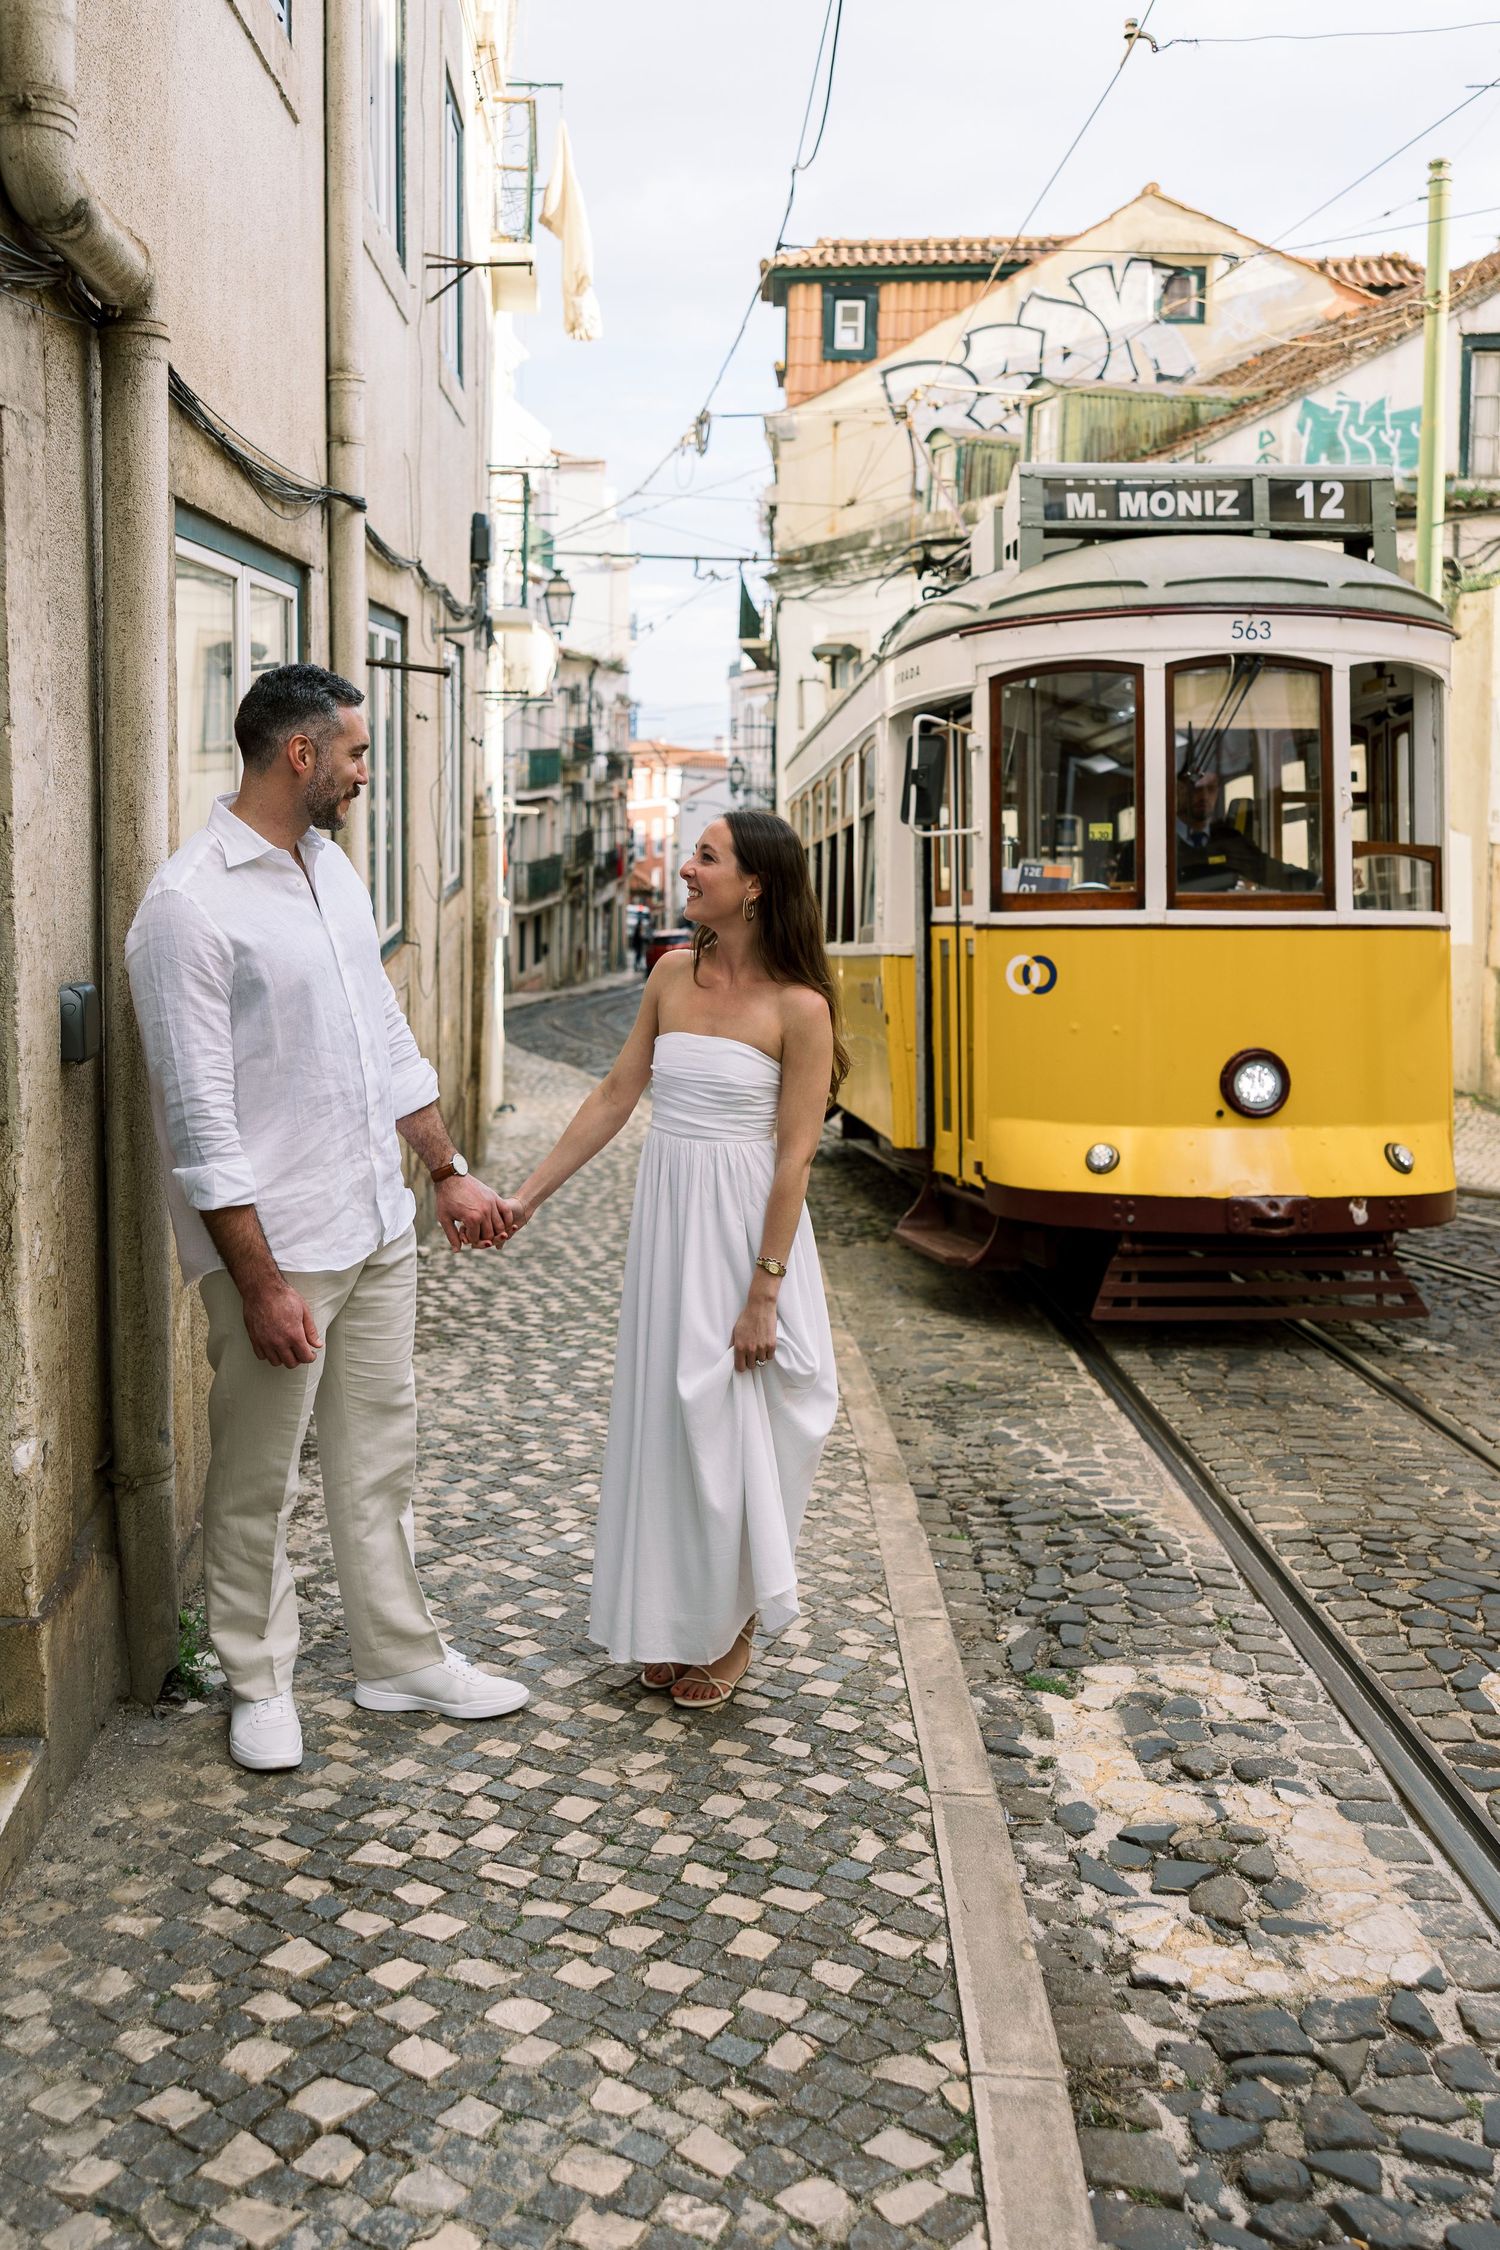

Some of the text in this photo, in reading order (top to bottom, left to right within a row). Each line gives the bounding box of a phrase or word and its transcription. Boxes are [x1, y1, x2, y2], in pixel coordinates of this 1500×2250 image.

[1065, 489, 1240, 519] M. MONIZ
[1295, 480, 1345, 519] 12
[1231, 620, 1271, 640] 563
